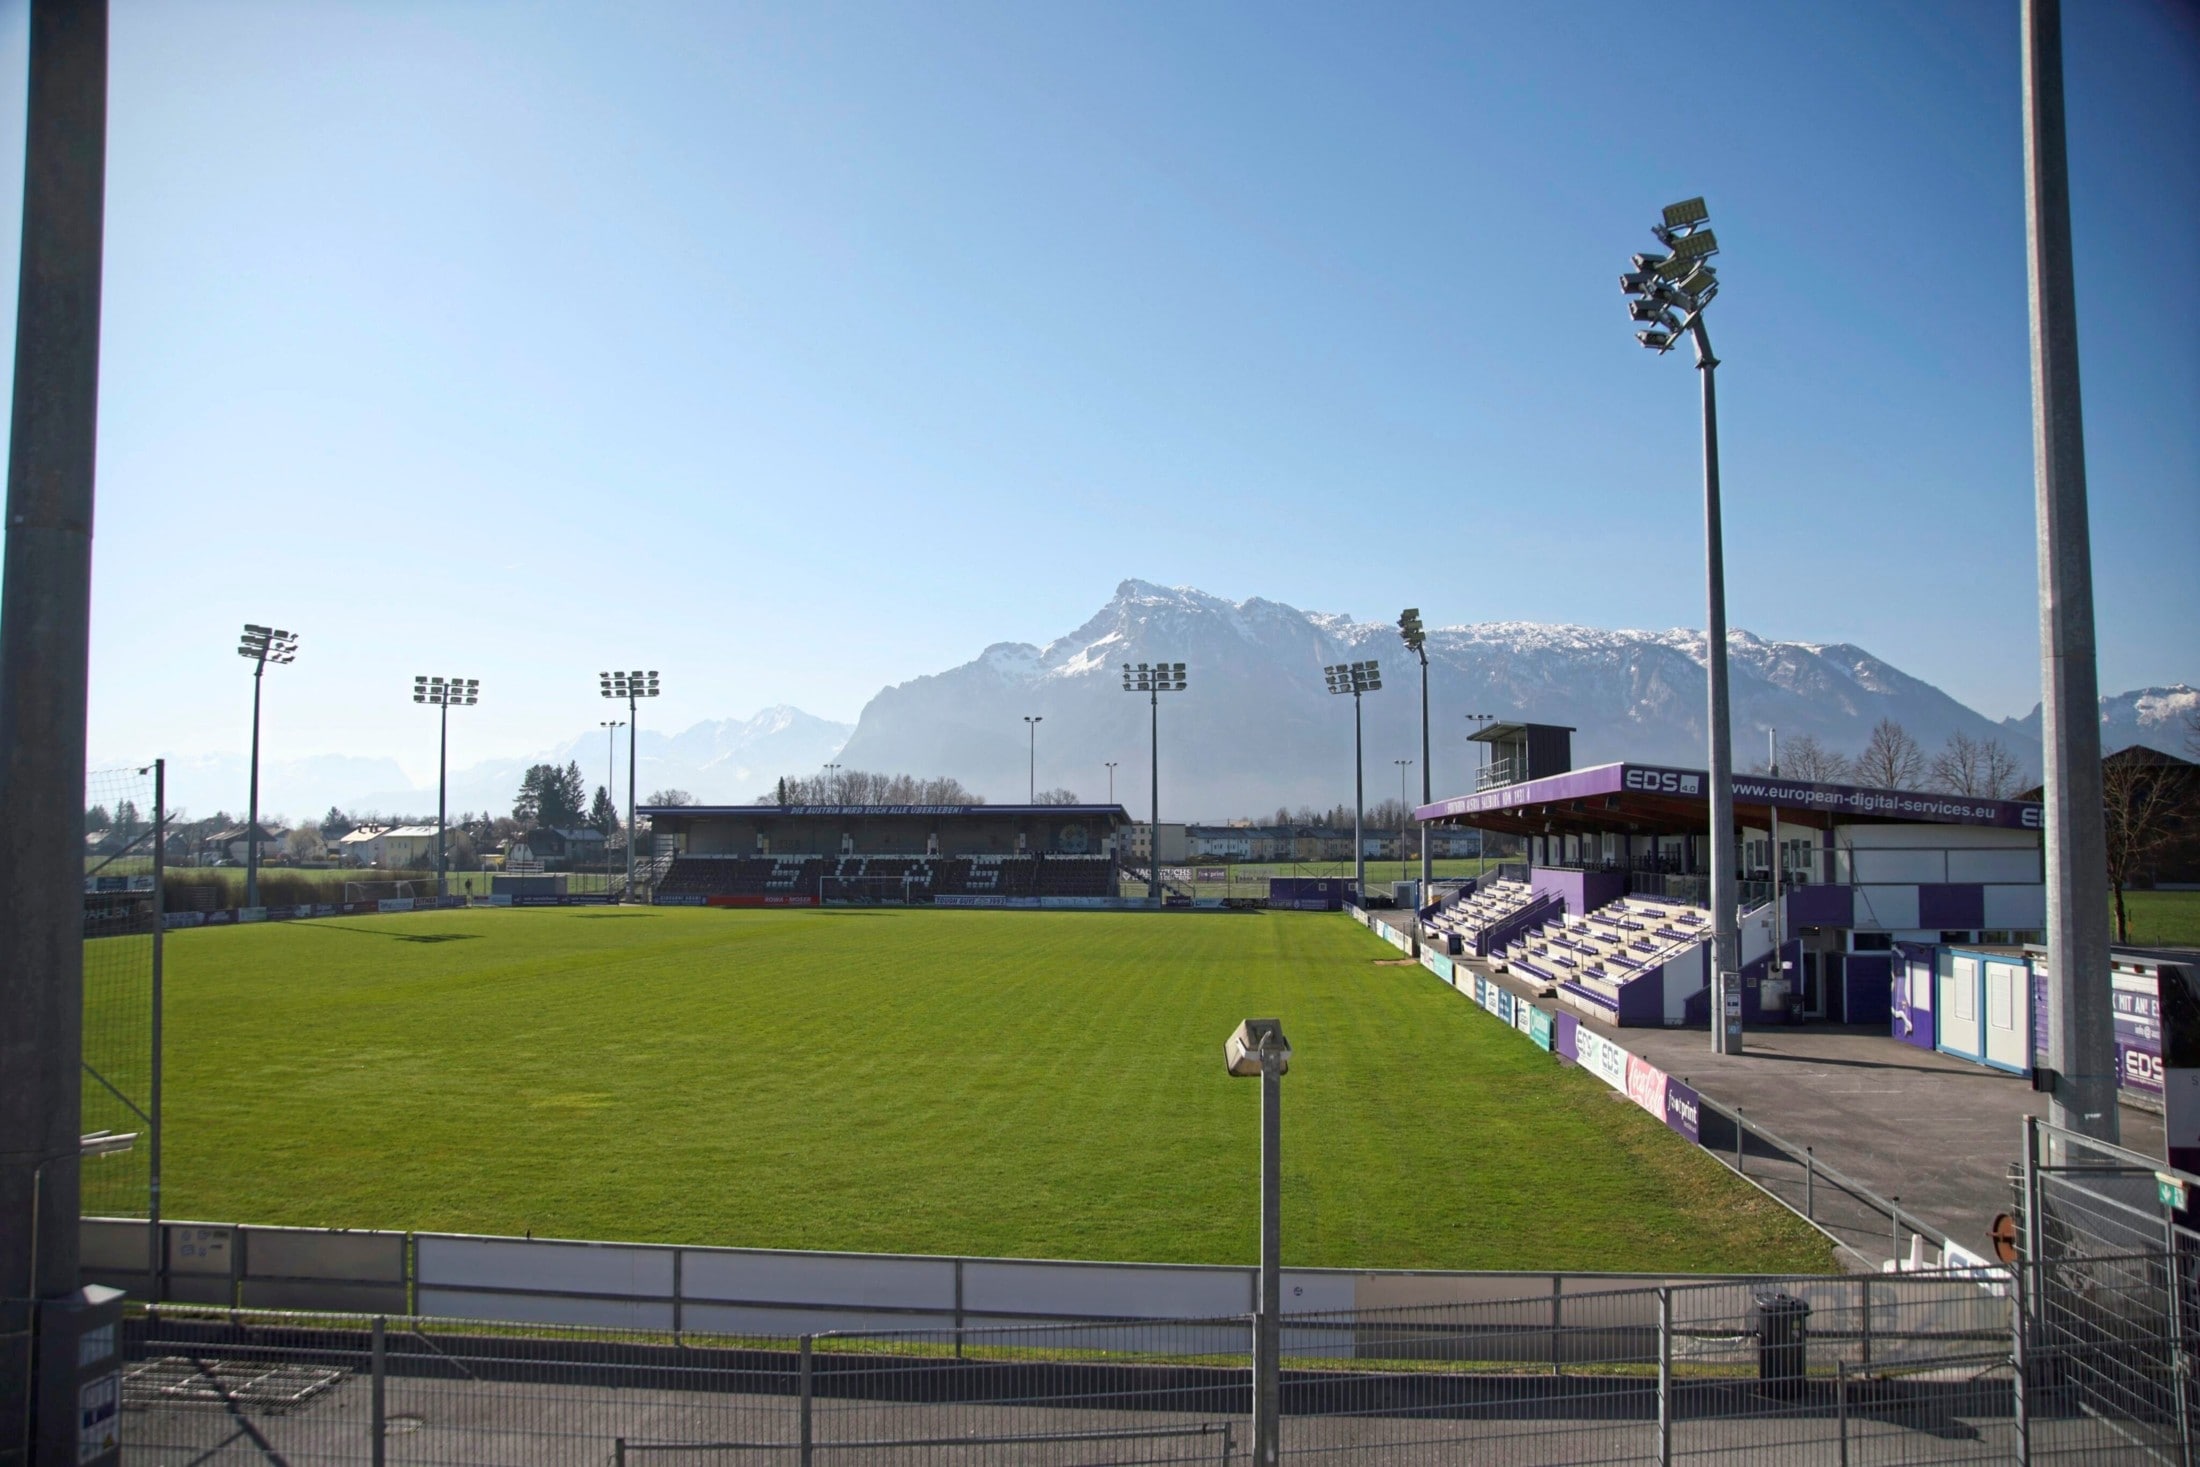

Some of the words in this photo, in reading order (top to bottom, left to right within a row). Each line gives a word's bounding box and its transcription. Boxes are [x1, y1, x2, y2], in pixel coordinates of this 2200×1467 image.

[1626, 770, 1678, 792] EDS
[1682, 784, 1696, 793] 4.0
[791, 806, 804, 815] DIE
[806, 806, 839, 815] AUSTRIA
[842, 806, 863, 815] WIRD
[865, 806, 887, 815] EUCH
[889, 806, 908, 815] ALLE
[1602, 1043, 1619, 1075] EDS
[2125, 1050, 2162, 1081] EDS
